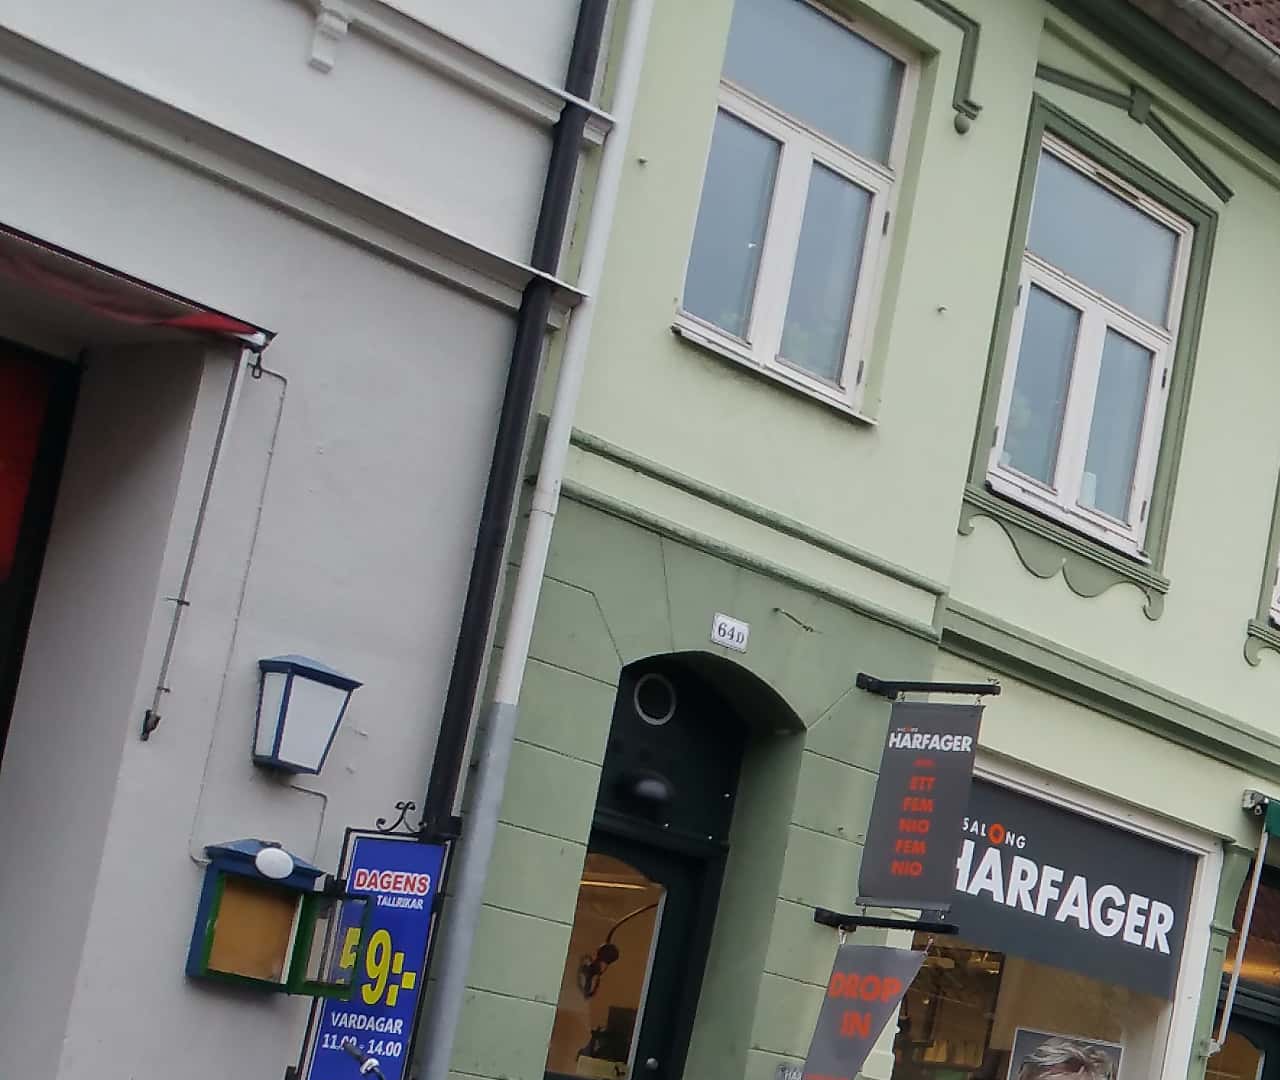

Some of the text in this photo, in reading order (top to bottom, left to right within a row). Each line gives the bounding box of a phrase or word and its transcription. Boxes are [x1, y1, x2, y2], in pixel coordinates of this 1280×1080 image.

[718, 622, 745, 644] 64D
[888, 733, 972, 752] HARFAGER
[910, 776, 936, 791] ETT
[903, 797, 934, 813] FEM
[898, 819, 930, 833] NIO
[961, 817, 1027, 849] SALONG
[895, 840, 927, 854] FEM
[890, 861, 923, 876] NIO
[352, 868, 430, 896] DAGENS
[376, 895, 423, 910] TALLRIKAR
[828, 970, 901, 1004] DROP
[331, 1012, 404, 1035] VARDAGAR
[840, 1009, 873, 1040] IN
[367, 1039, 402, 1057] 14.00
